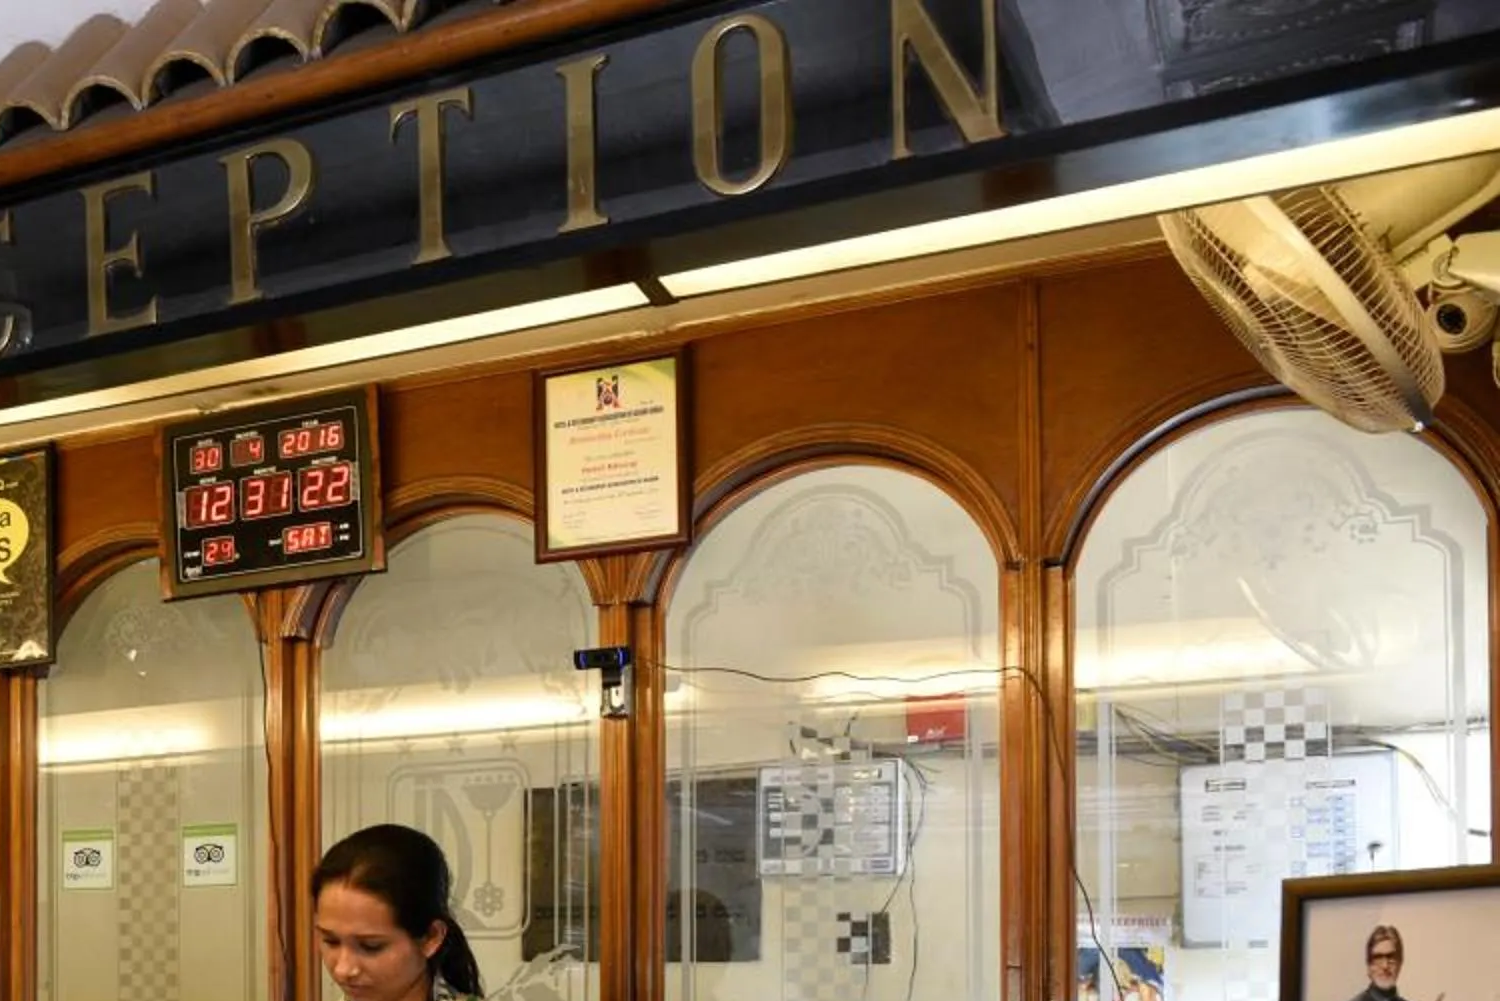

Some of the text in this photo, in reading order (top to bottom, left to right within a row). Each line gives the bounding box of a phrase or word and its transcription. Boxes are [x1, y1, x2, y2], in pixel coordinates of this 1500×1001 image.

[282, 425, 341, 455] 2016
[201, 466, 349, 521] 12 31 22
[287, 524, 331, 551] SAT
